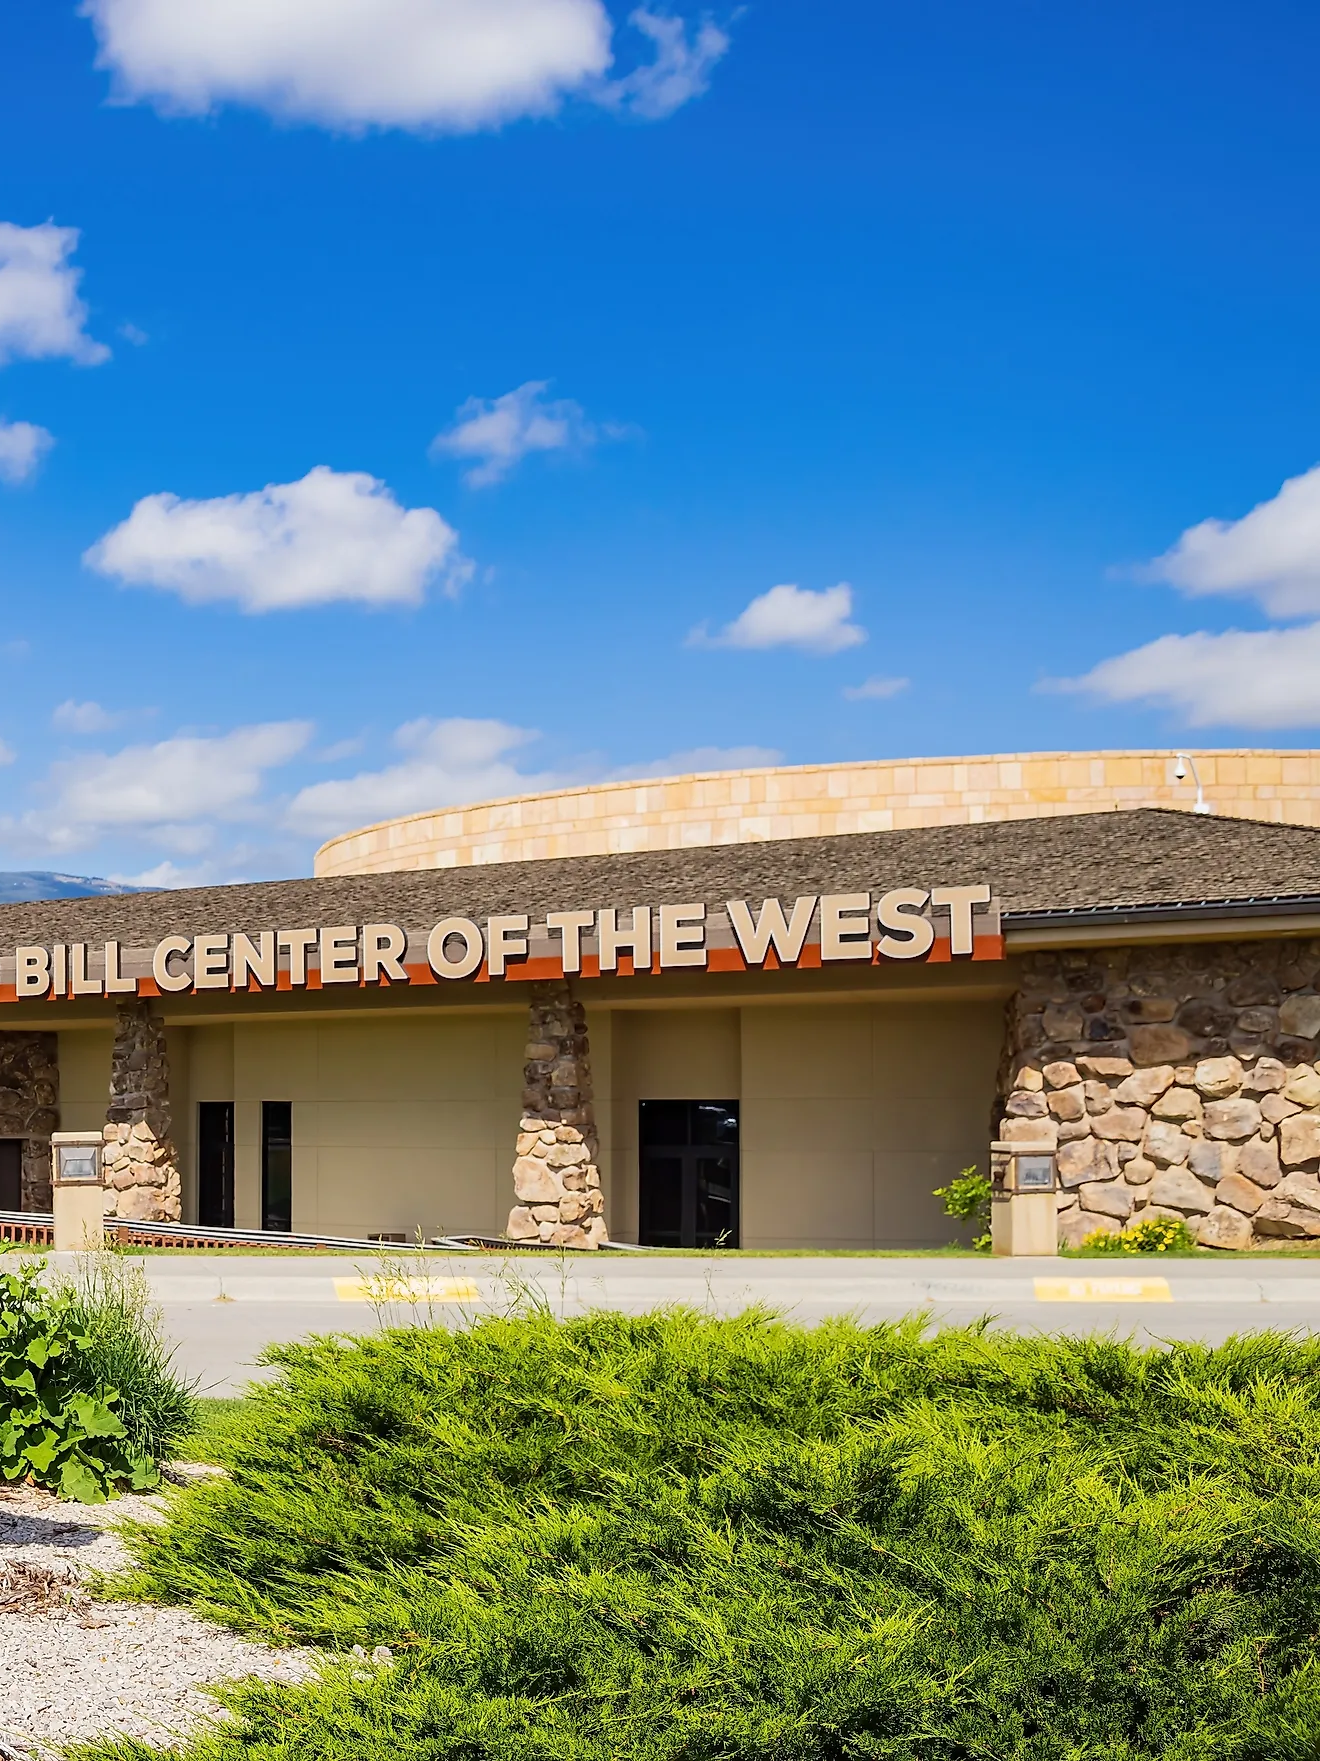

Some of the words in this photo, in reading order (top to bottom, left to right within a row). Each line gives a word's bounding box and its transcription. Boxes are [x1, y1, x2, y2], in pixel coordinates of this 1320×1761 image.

[15, 941, 136, 997] BILL
[153, 923, 408, 993] CENTER
[427, 914, 529, 980] OF
[547, 903, 707, 973] THE
[726, 884, 990, 964] WEST
